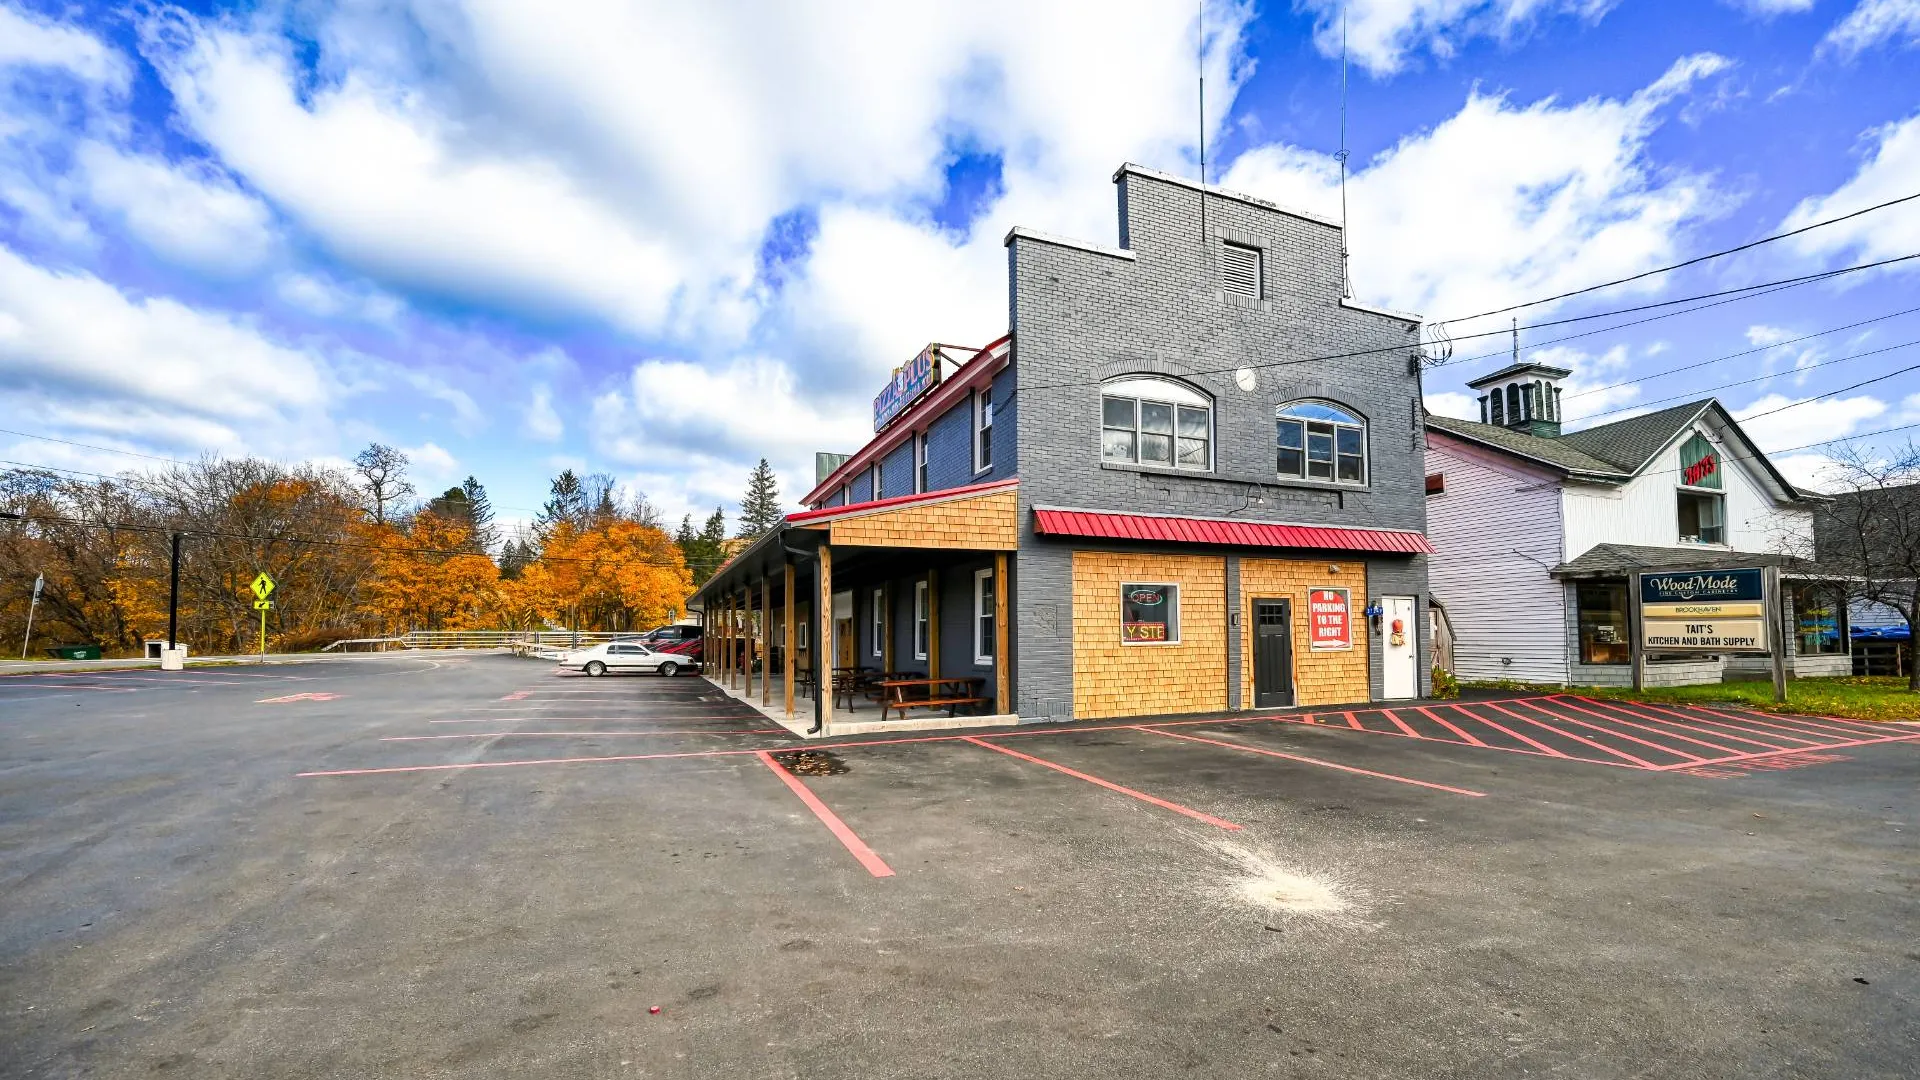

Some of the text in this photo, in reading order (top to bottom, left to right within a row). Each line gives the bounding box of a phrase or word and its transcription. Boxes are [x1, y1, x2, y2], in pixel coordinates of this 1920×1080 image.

[875, 376, 904, 416] PIZZA
[903, 345, 933, 393] PLUS
[1132, 593, 1160, 602] OPEN
[1323, 590, 1334, 600] NO
[1312, 603, 1346, 612] PARKING
[1317, 615, 1343, 624] TO THE
[1318, 627, 1342, 637] RIGHT
[1685, 624, 1713, 634] TAIT'S
[1648, 636, 1755, 646] KITCHEN AND BATH SUPPLY
